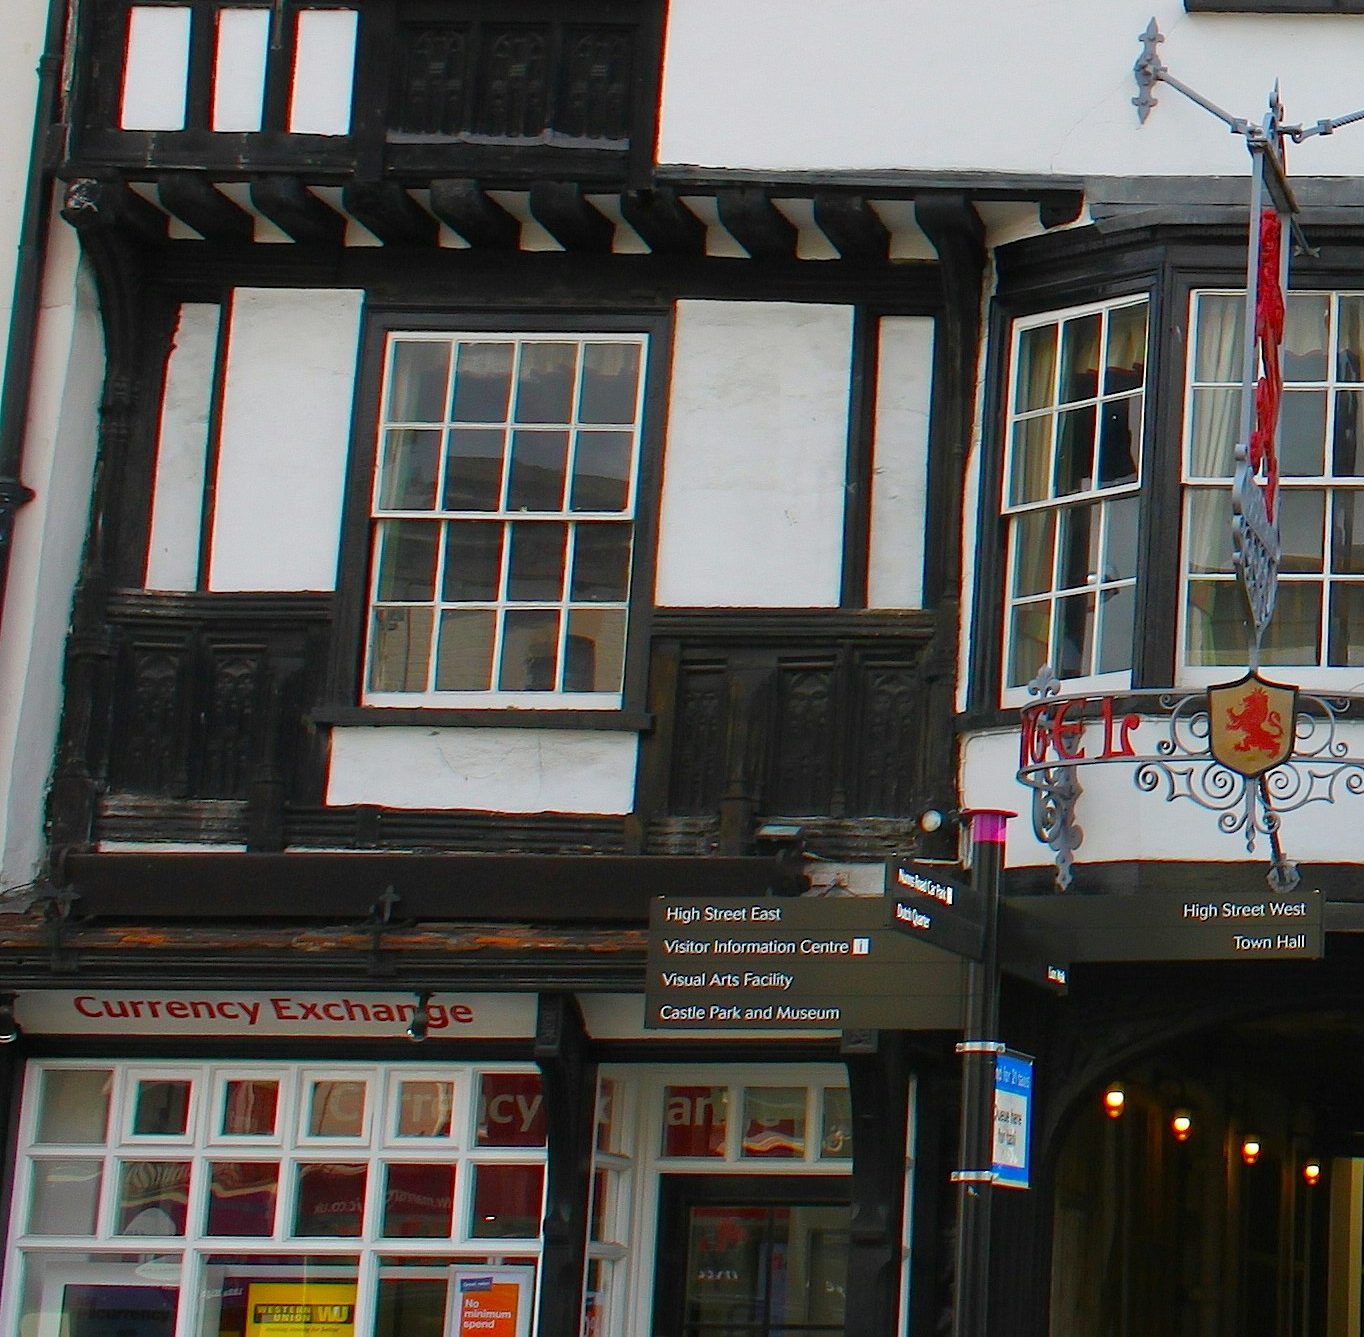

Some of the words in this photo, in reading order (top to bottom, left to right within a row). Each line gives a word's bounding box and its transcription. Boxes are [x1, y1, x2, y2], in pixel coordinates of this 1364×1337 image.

[665, 906, 700, 924] High
[704, 906, 747, 922] Street
[751, 906, 782, 922] East
[1183, 903, 1218, 922] High
[1222, 902, 1266, 917] Street
[1269, 902, 1307, 917] West
[663, 938, 710, 955] Visitor
[713, 938, 796, 955] Information
[799, 938, 850, 955] Centre
[1233, 934, 1272, 950] Town
[1276, 934, 1306, 950] Hall
[661, 972, 706, 988] Visual
[708, 972, 740, 988] Arts
[743, 971, 794, 991] Facility
[74, 995, 262, 1027] Currency
[269, 997, 474, 1030] Exchange
[659, 1005, 706, 1021] Castle
[709, 1005, 742, 1021] Park
[744, 1005, 773, 1021] and
[775, 1005, 841, 1021] Museum
[464, 1298, 480, 1309] No
[257, 1305, 312, 1313] WESTERN
[317, 1305, 351, 1322] WU
[273, 1313, 312, 1322] UNION
[463, 1308, 512, 1319] minimum
[463, 1319, 496, 1331] spend
